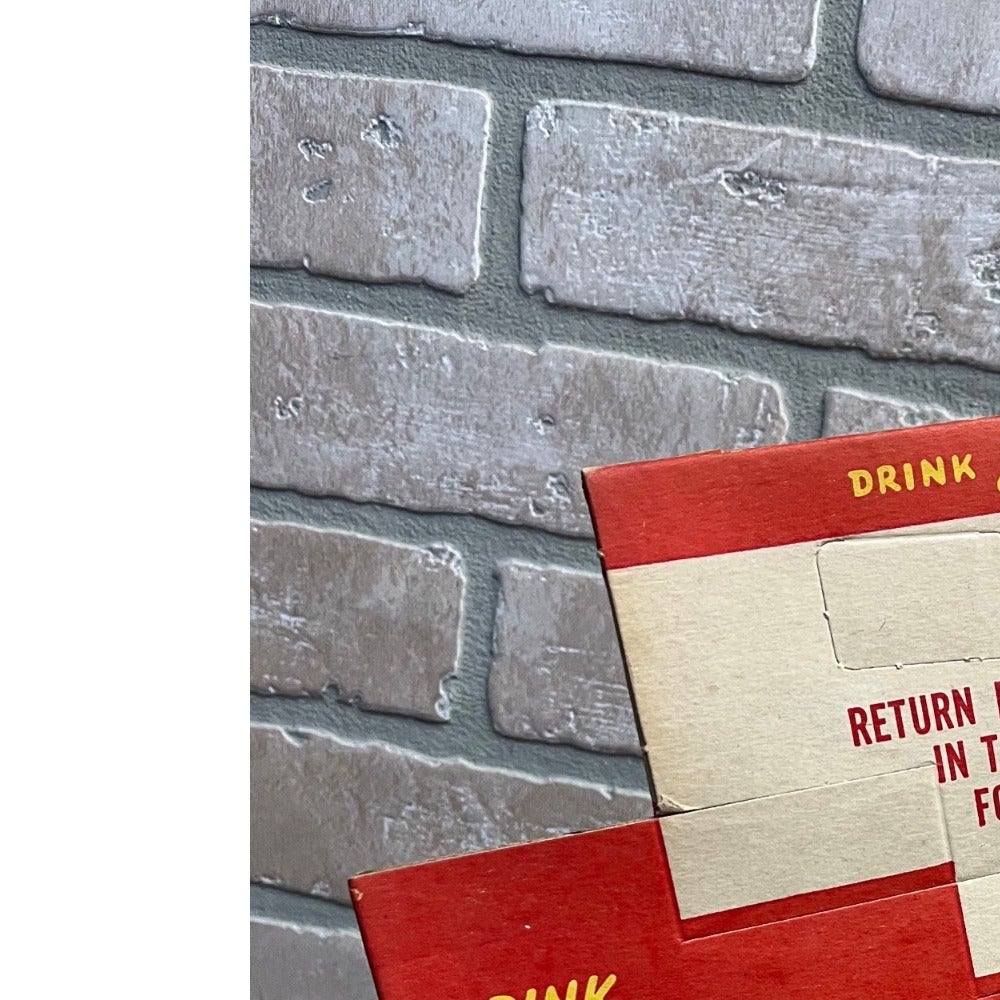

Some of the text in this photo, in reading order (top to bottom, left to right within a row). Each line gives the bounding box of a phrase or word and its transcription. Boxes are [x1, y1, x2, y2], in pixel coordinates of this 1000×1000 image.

[848, 454, 976, 497] DRINK
[848, 686, 977, 748] RETURN
[933, 740, 970, 784] IN
